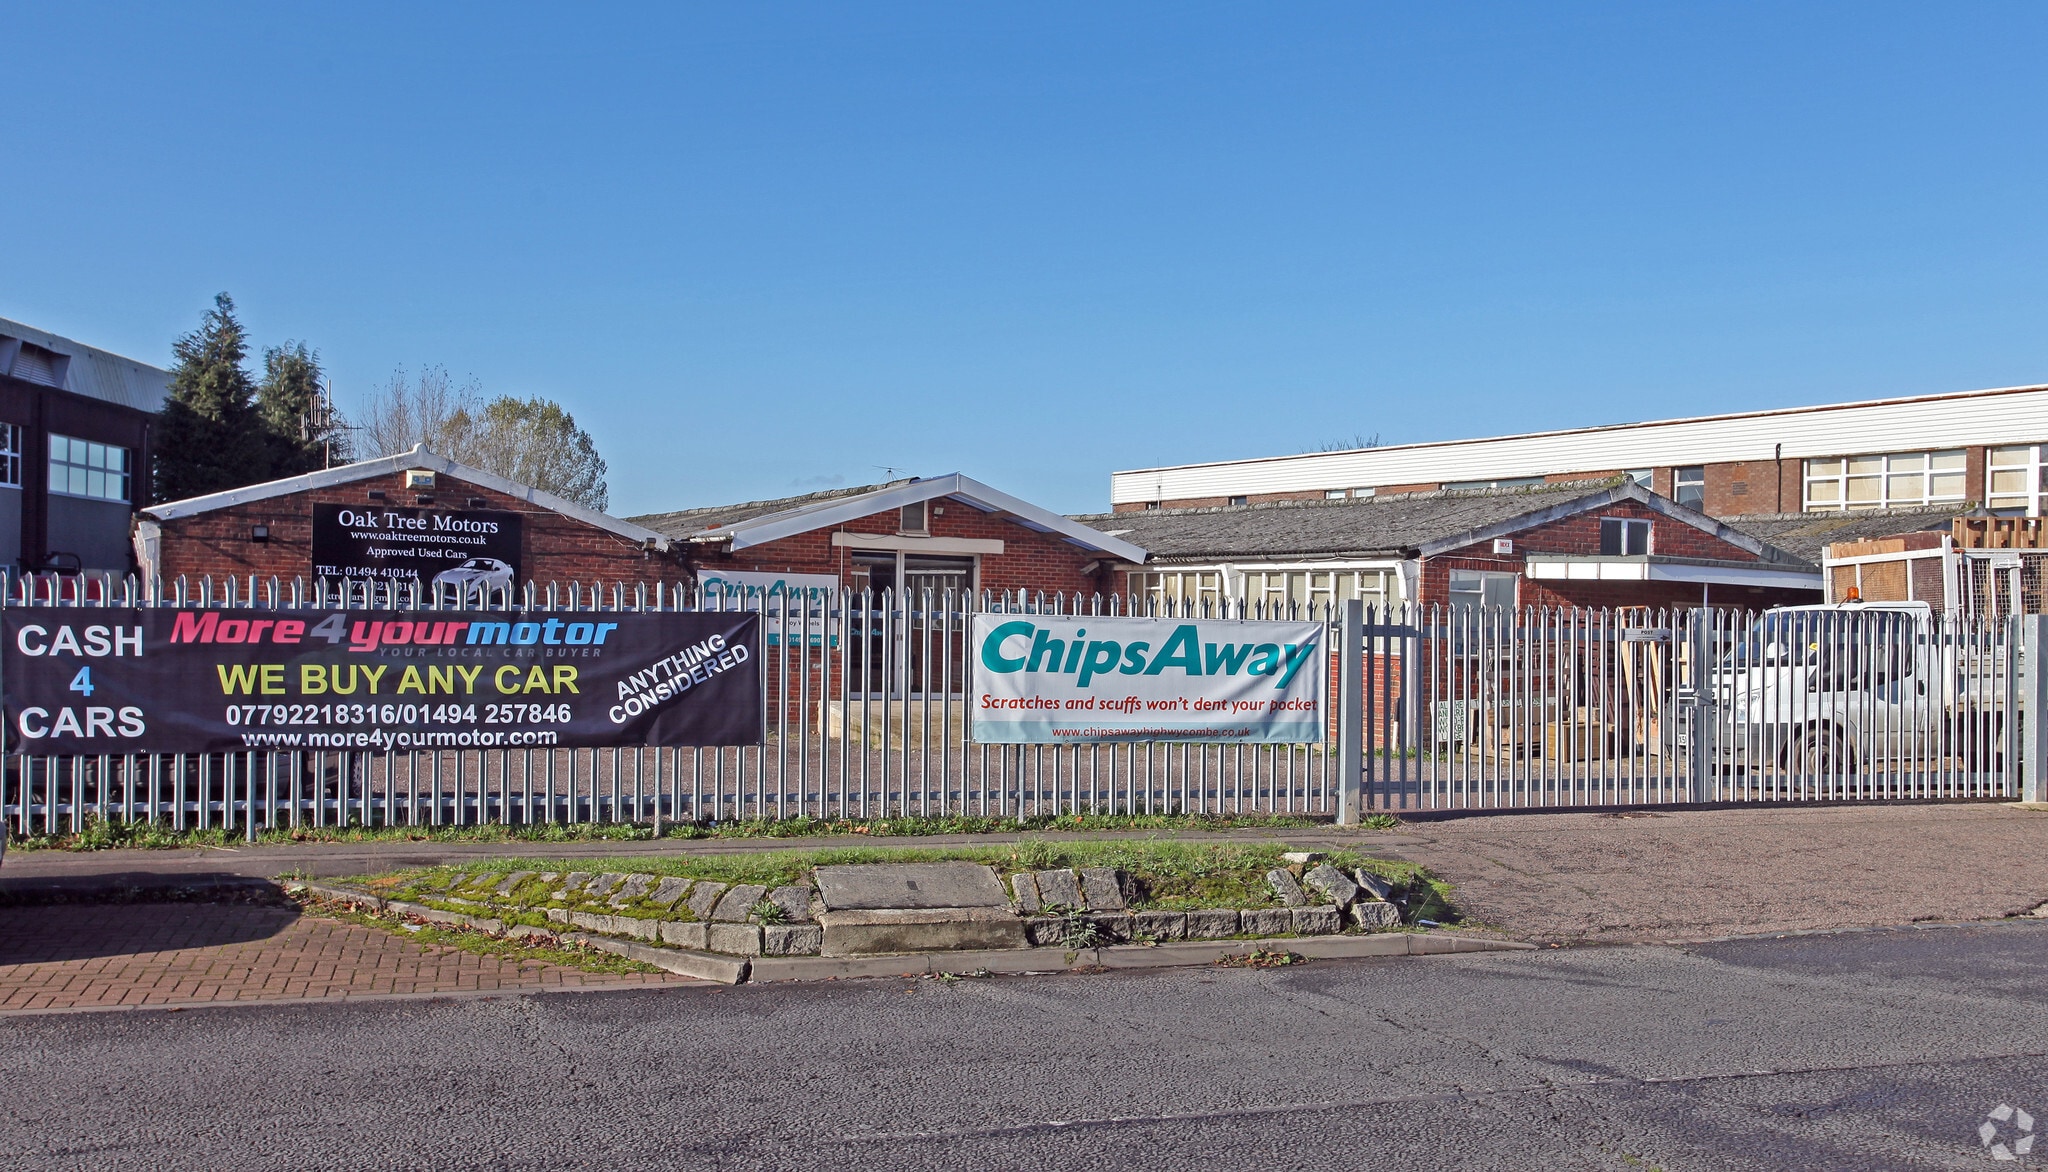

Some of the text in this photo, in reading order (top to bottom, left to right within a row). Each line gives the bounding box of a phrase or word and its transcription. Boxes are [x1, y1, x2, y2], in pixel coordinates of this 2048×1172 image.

[338, 510, 499, 533] Oak Tree Motors
[351, 531, 487, 545] www.oaktreemotors.co.uk
[366, 546, 467, 559] Approved Used Cars
[316, 565, 418, 578] TEL: 01494 410144
[17, 625, 143, 657] CASH
[379, 647, 601, 658] YOUR LOCAL CAR BUYER
[981, 620, 1316, 689] ChipsAway
[617, 633, 726, 700] ANYTHING
[69, 666, 95, 696] 4
[217, 664, 580, 694] WE BUY ANY CAR
[609, 643, 749, 724] CONSIDERED
[225, 703, 571, 725] 07792218316/01494 257846
[981, 694, 1318, 715] Scratches and scuffs won't dent your pocket
[19, 706, 146, 738] CARS
[1052, 725, 1250, 738] www.chipsawayhighwycombe.co.uk
[241, 728, 558, 750] www.more4yourmotor.com
